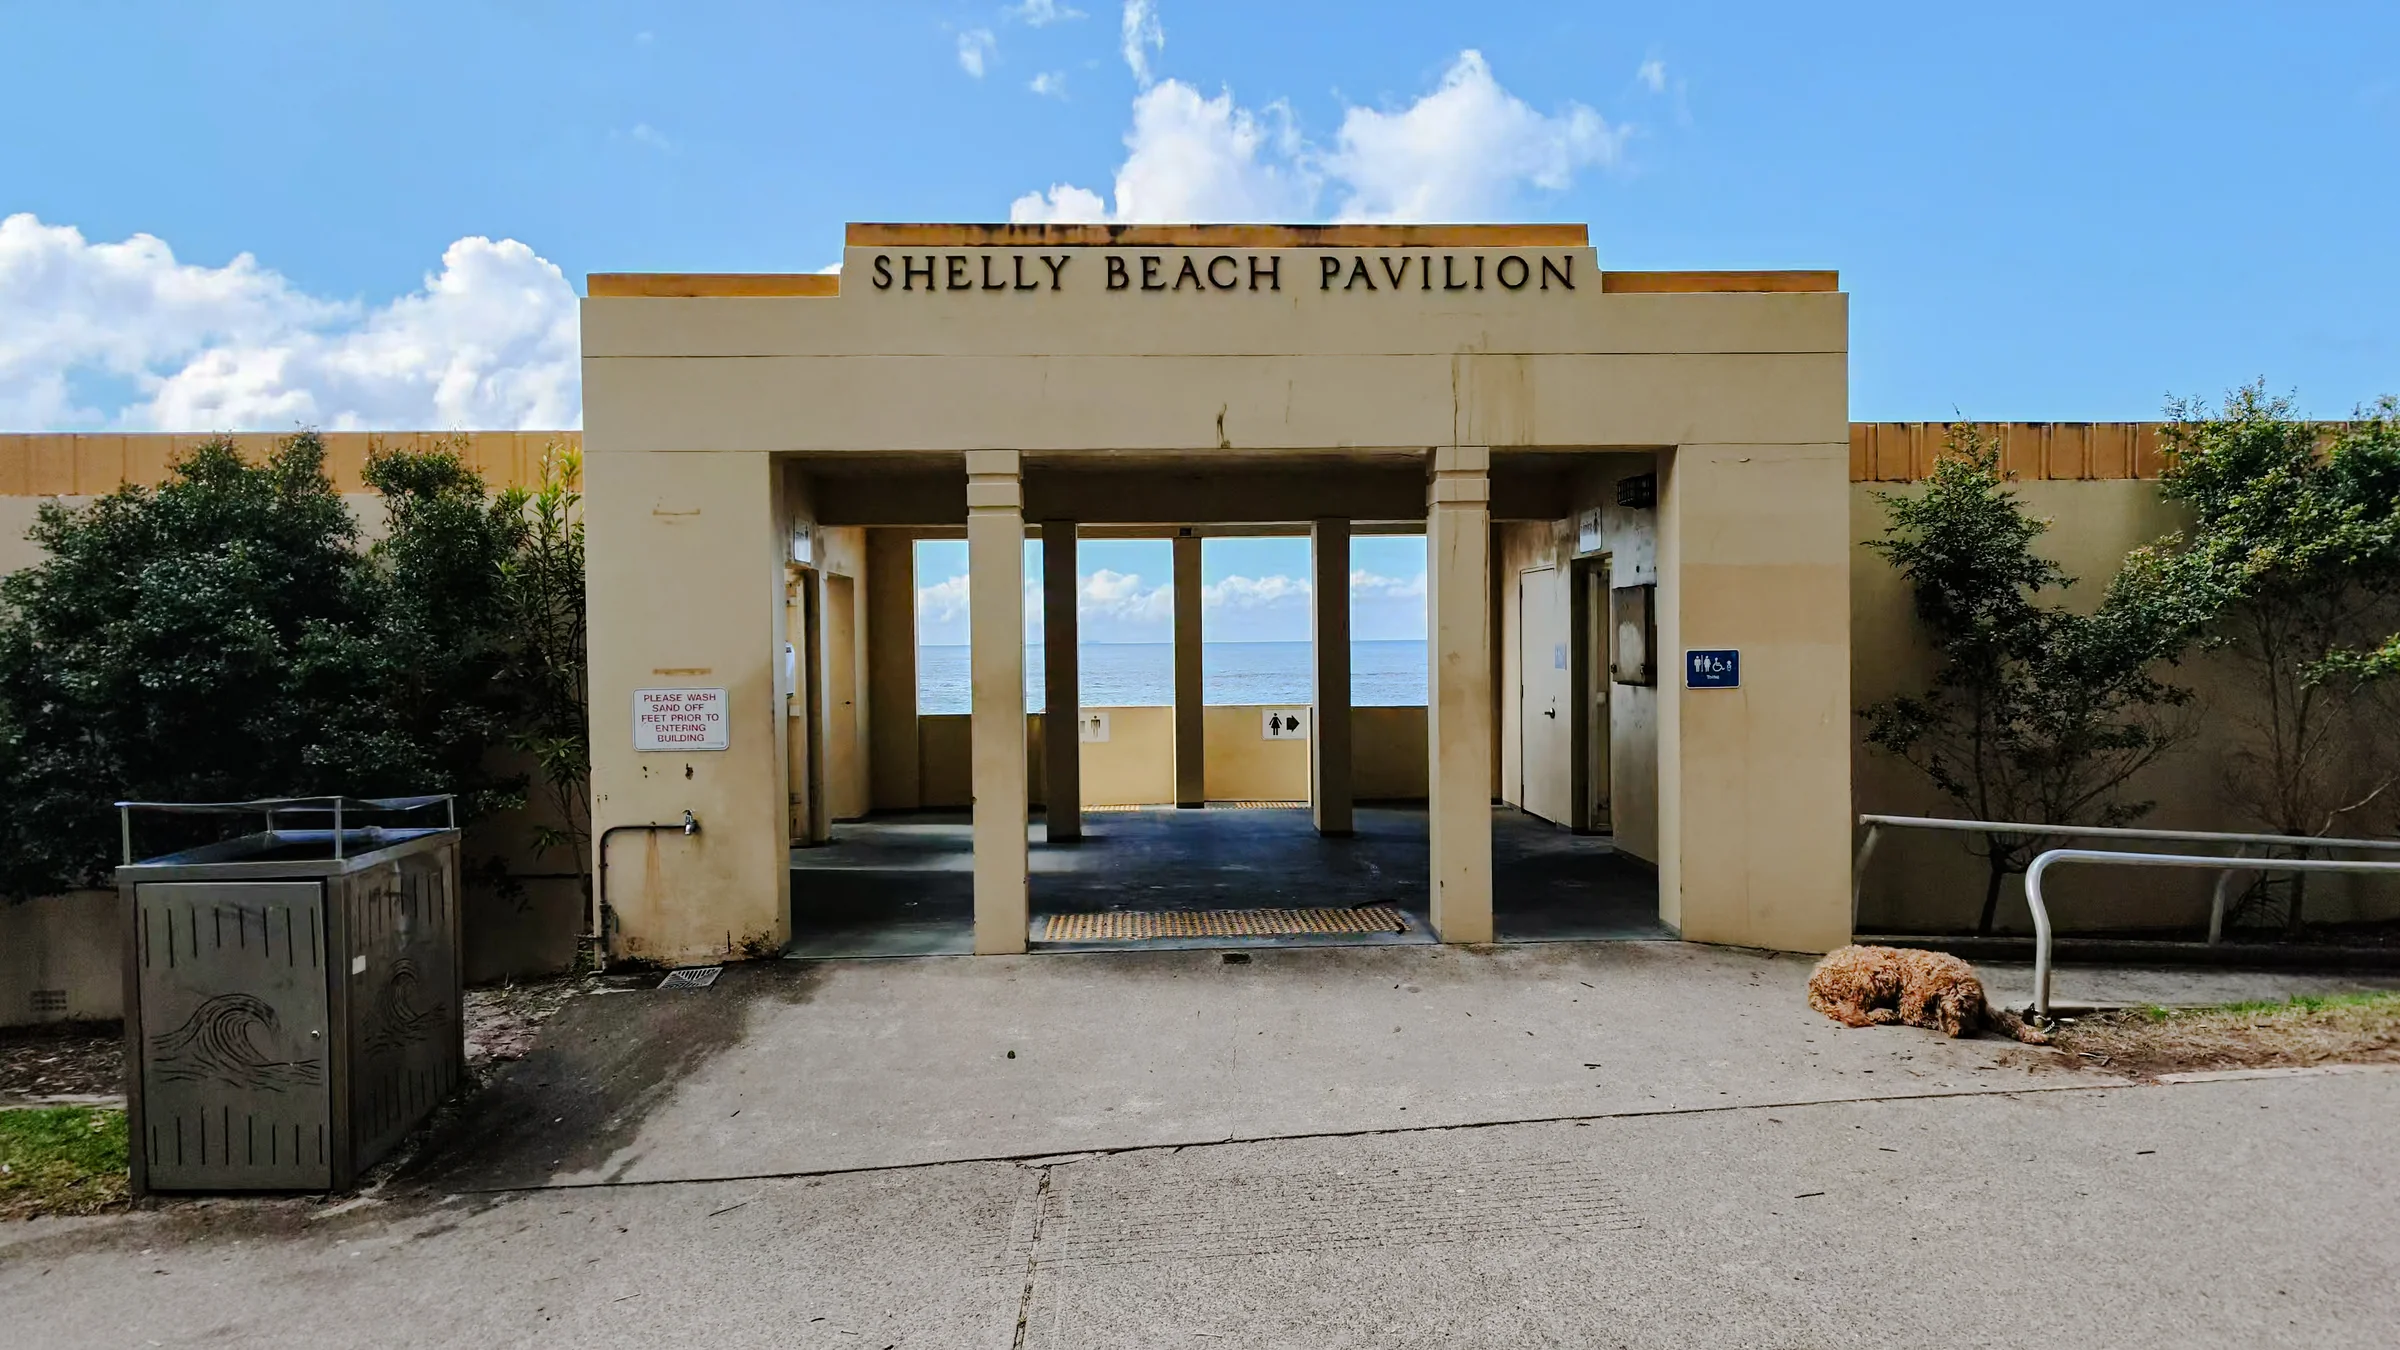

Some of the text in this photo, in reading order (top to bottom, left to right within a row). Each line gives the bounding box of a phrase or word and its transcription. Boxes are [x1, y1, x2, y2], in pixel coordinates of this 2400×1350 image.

[872, 254, 1575, 291] SHELLY BEACH PAVILION
[643, 693, 716, 702] PLEASE WASH
[652, 703, 704, 712] SAND OFF
[641, 713, 719, 722] FEET PRIOR TO
[655, 724, 706, 732] ENTERING
[657, 734, 704, 742] BUILDING
